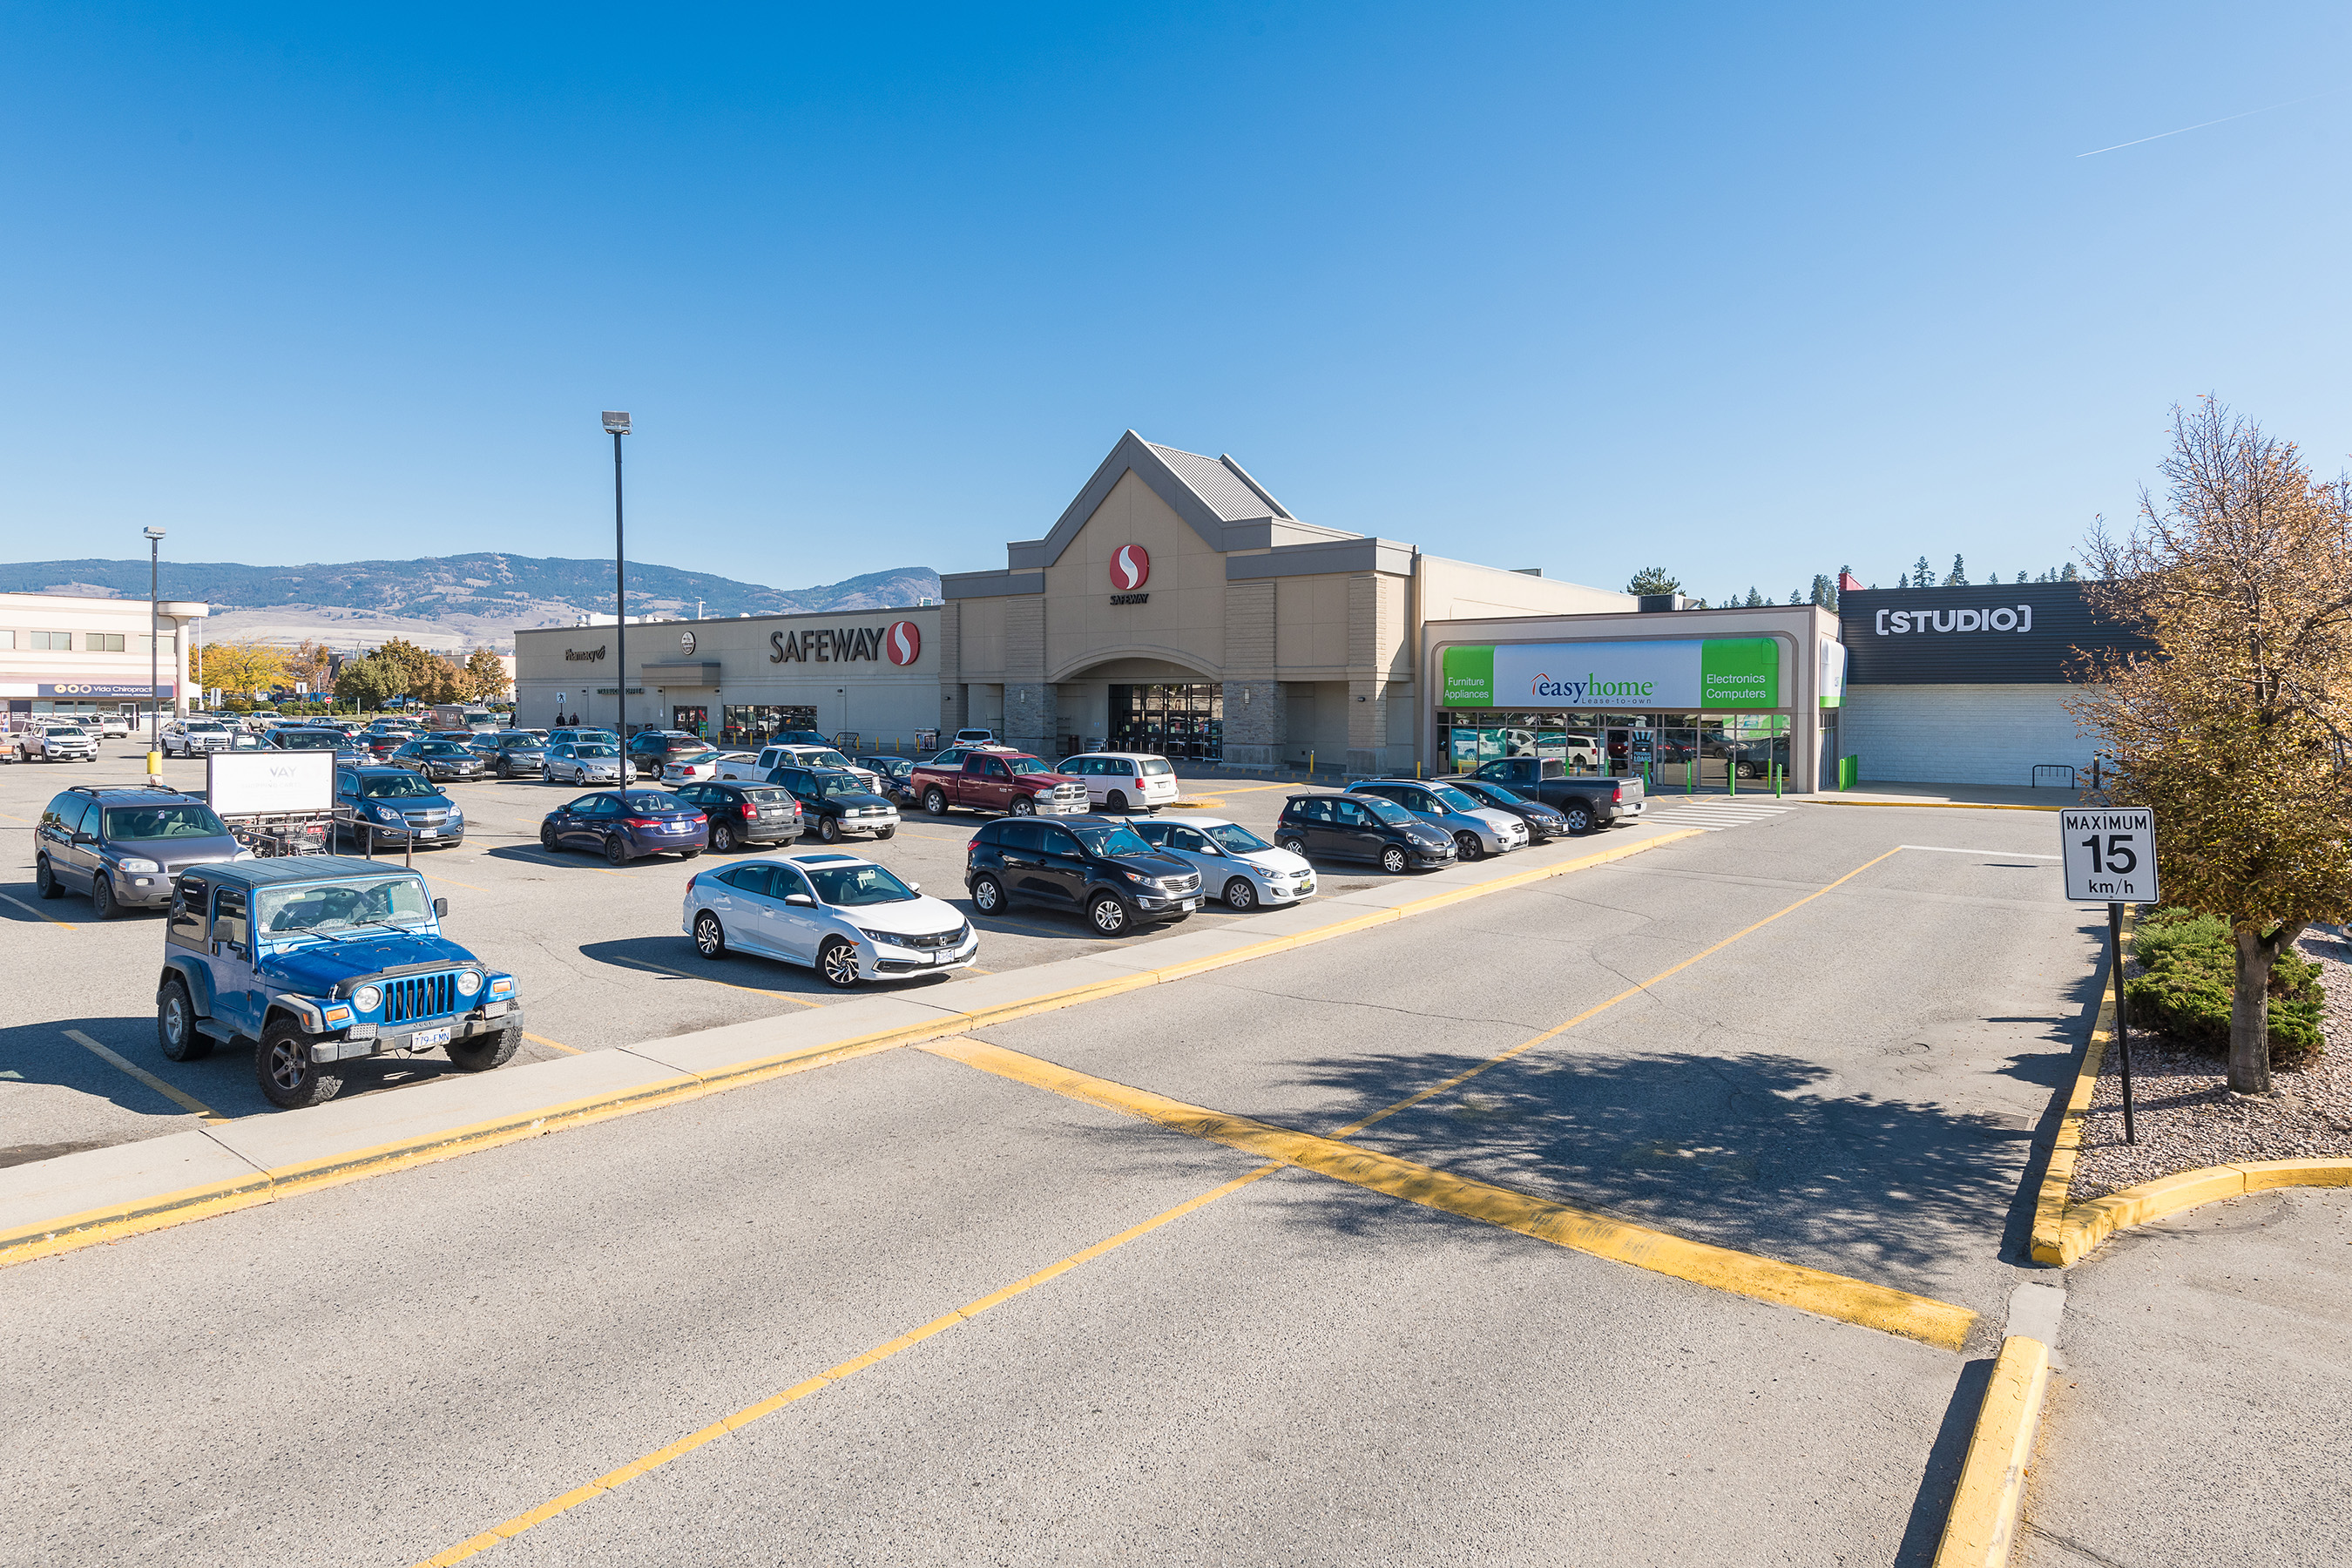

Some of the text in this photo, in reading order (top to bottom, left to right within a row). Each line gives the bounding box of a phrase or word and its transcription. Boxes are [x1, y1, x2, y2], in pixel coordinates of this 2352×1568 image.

[1110, 593, 1149, 605] SAFEWAY
[770, 627, 885, 664] SAFEWAY
[565, 648, 598, 662] Pharmacy
[1448, 677, 1484, 686] Furniture
[1707, 673, 1766, 684] Electronics
[1443, 689, 1489, 700] Appliances
[1538, 672, 1653, 704] easyhome
[1706, 688, 1767, 700] Computers
[2065, 815, 2147, 830] MAXIMUM
[2081, 835, 2137, 874] 15
[2088, 878, 2134, 895] km/h
